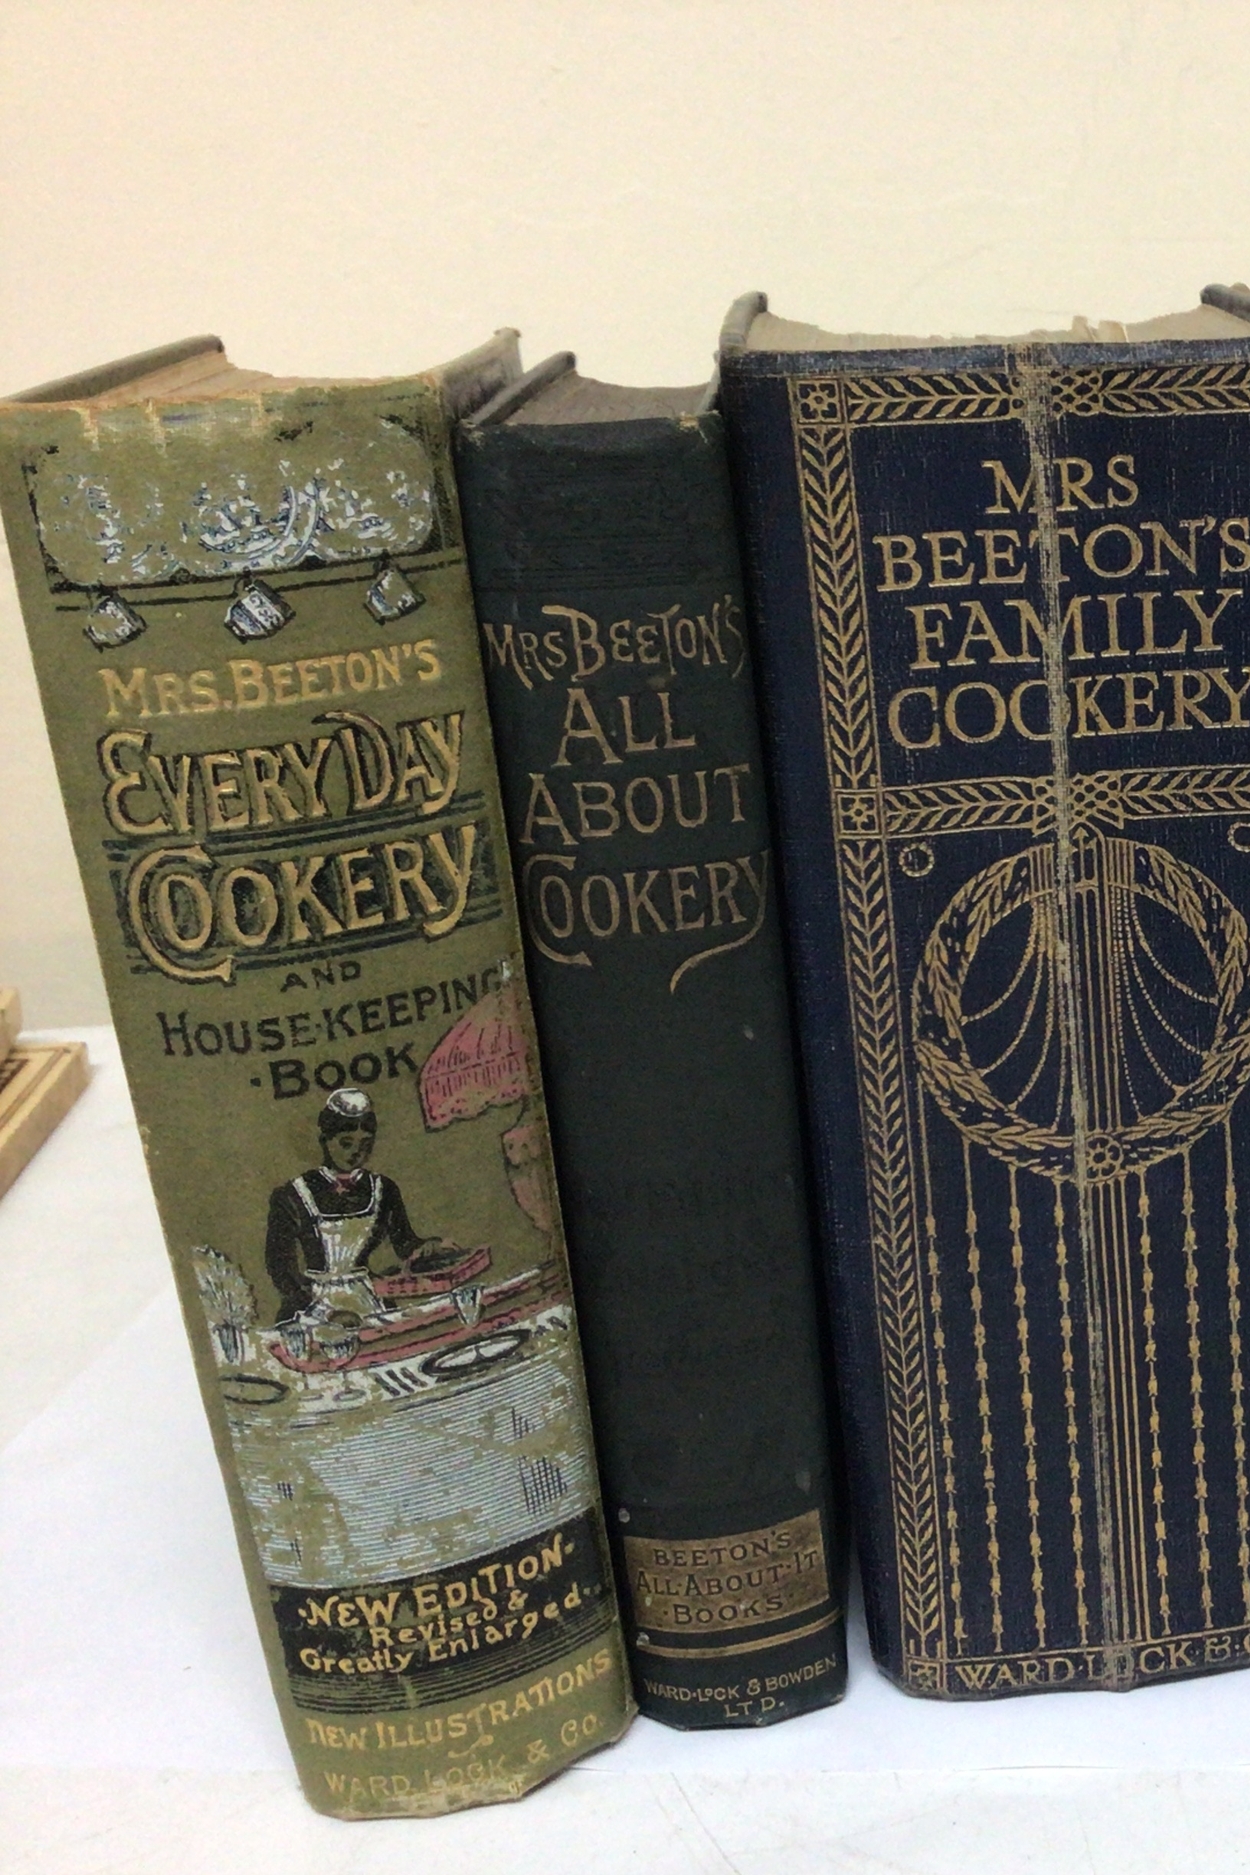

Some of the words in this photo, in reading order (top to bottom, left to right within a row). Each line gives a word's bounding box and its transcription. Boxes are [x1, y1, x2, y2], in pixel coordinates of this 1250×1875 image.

[981, 454, 1140, 515] MRS
[541, 594, 746, 683] BEETON'S
[904, 588, 1244, 671] FAMILY
[231, 639, 443, 709] BEETON'S
[551, 687, 697, 767] ALL
[519, 763, 750, 846] ABOUT
[126, 820, 478, 986] COOKERY
[522, 849, 770, 994] COOKERY
[280, 959, 362, 994] AND
[652, 1530, 792, 1568] BEETON'S
[370, 1596, 498, 1649] Revised
[507, 1588, 530, 1611] &
[299, 1647, 415, 1675] Greatly
[746, 1678, 761, 1696] &
[764, 1654, 838, 1692] BOWDEN
[956, 1656, 1074, 1691] WARD
[1204, 1637, 1232, 1662] &
[304, 1717, 367, 1751] NEW
[375, 1648, 613, 1759] ILLUSTRATIONS
[526, 1738, 550, 1765] &
